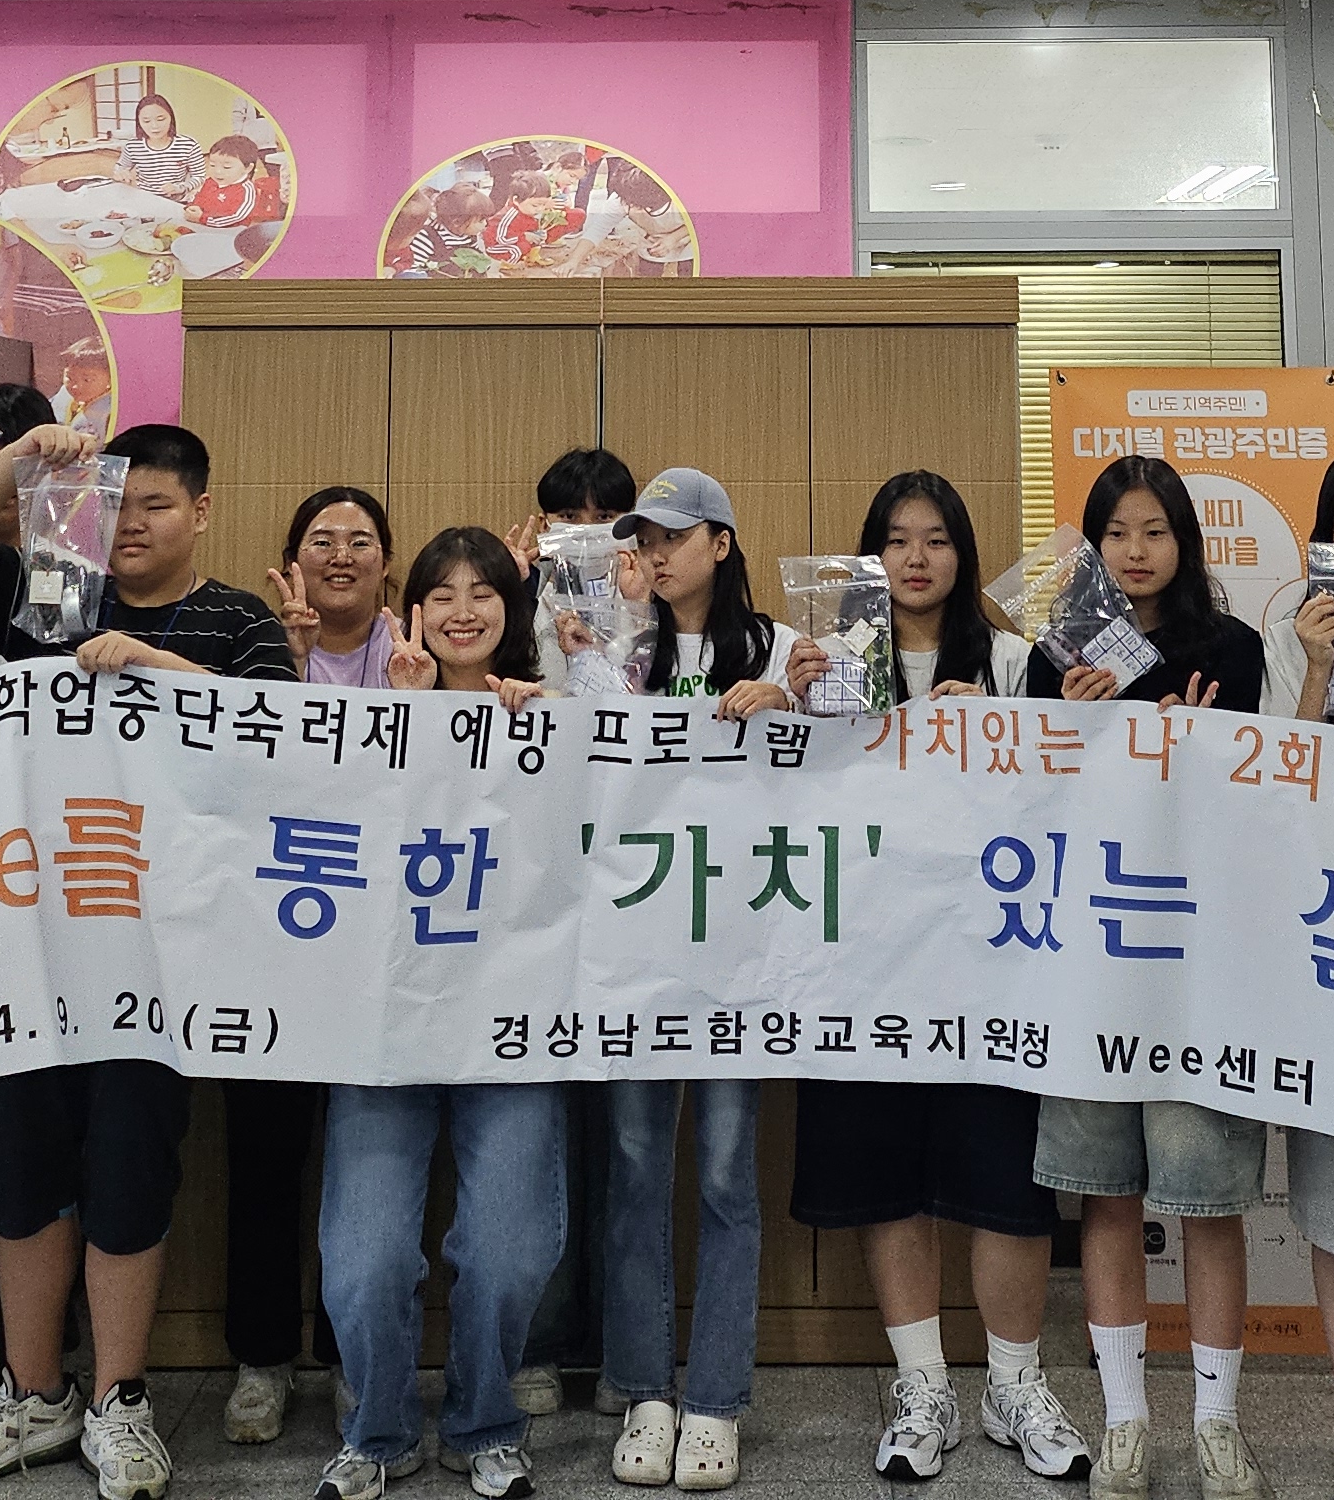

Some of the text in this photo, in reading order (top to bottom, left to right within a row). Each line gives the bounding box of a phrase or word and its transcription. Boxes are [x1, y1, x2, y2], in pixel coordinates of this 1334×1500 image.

[1148, 396, 1247, 412] 나도 지역주민!
[1073, 427, 1328, 459] 디지털 관광주민증
[1199, 499, 1243, 527] 내미
[1205, 536, 1259, 566] 마을
[450, 704, 555, 775] 예방
[588, 709, 812, 769] 프로그램
[255, 815, 499, 946] 통한
[981, 832, 1197, 960] 있는
[491, 1010, 1315, 1106] 경상남도함양교육지원청 Wee센터
